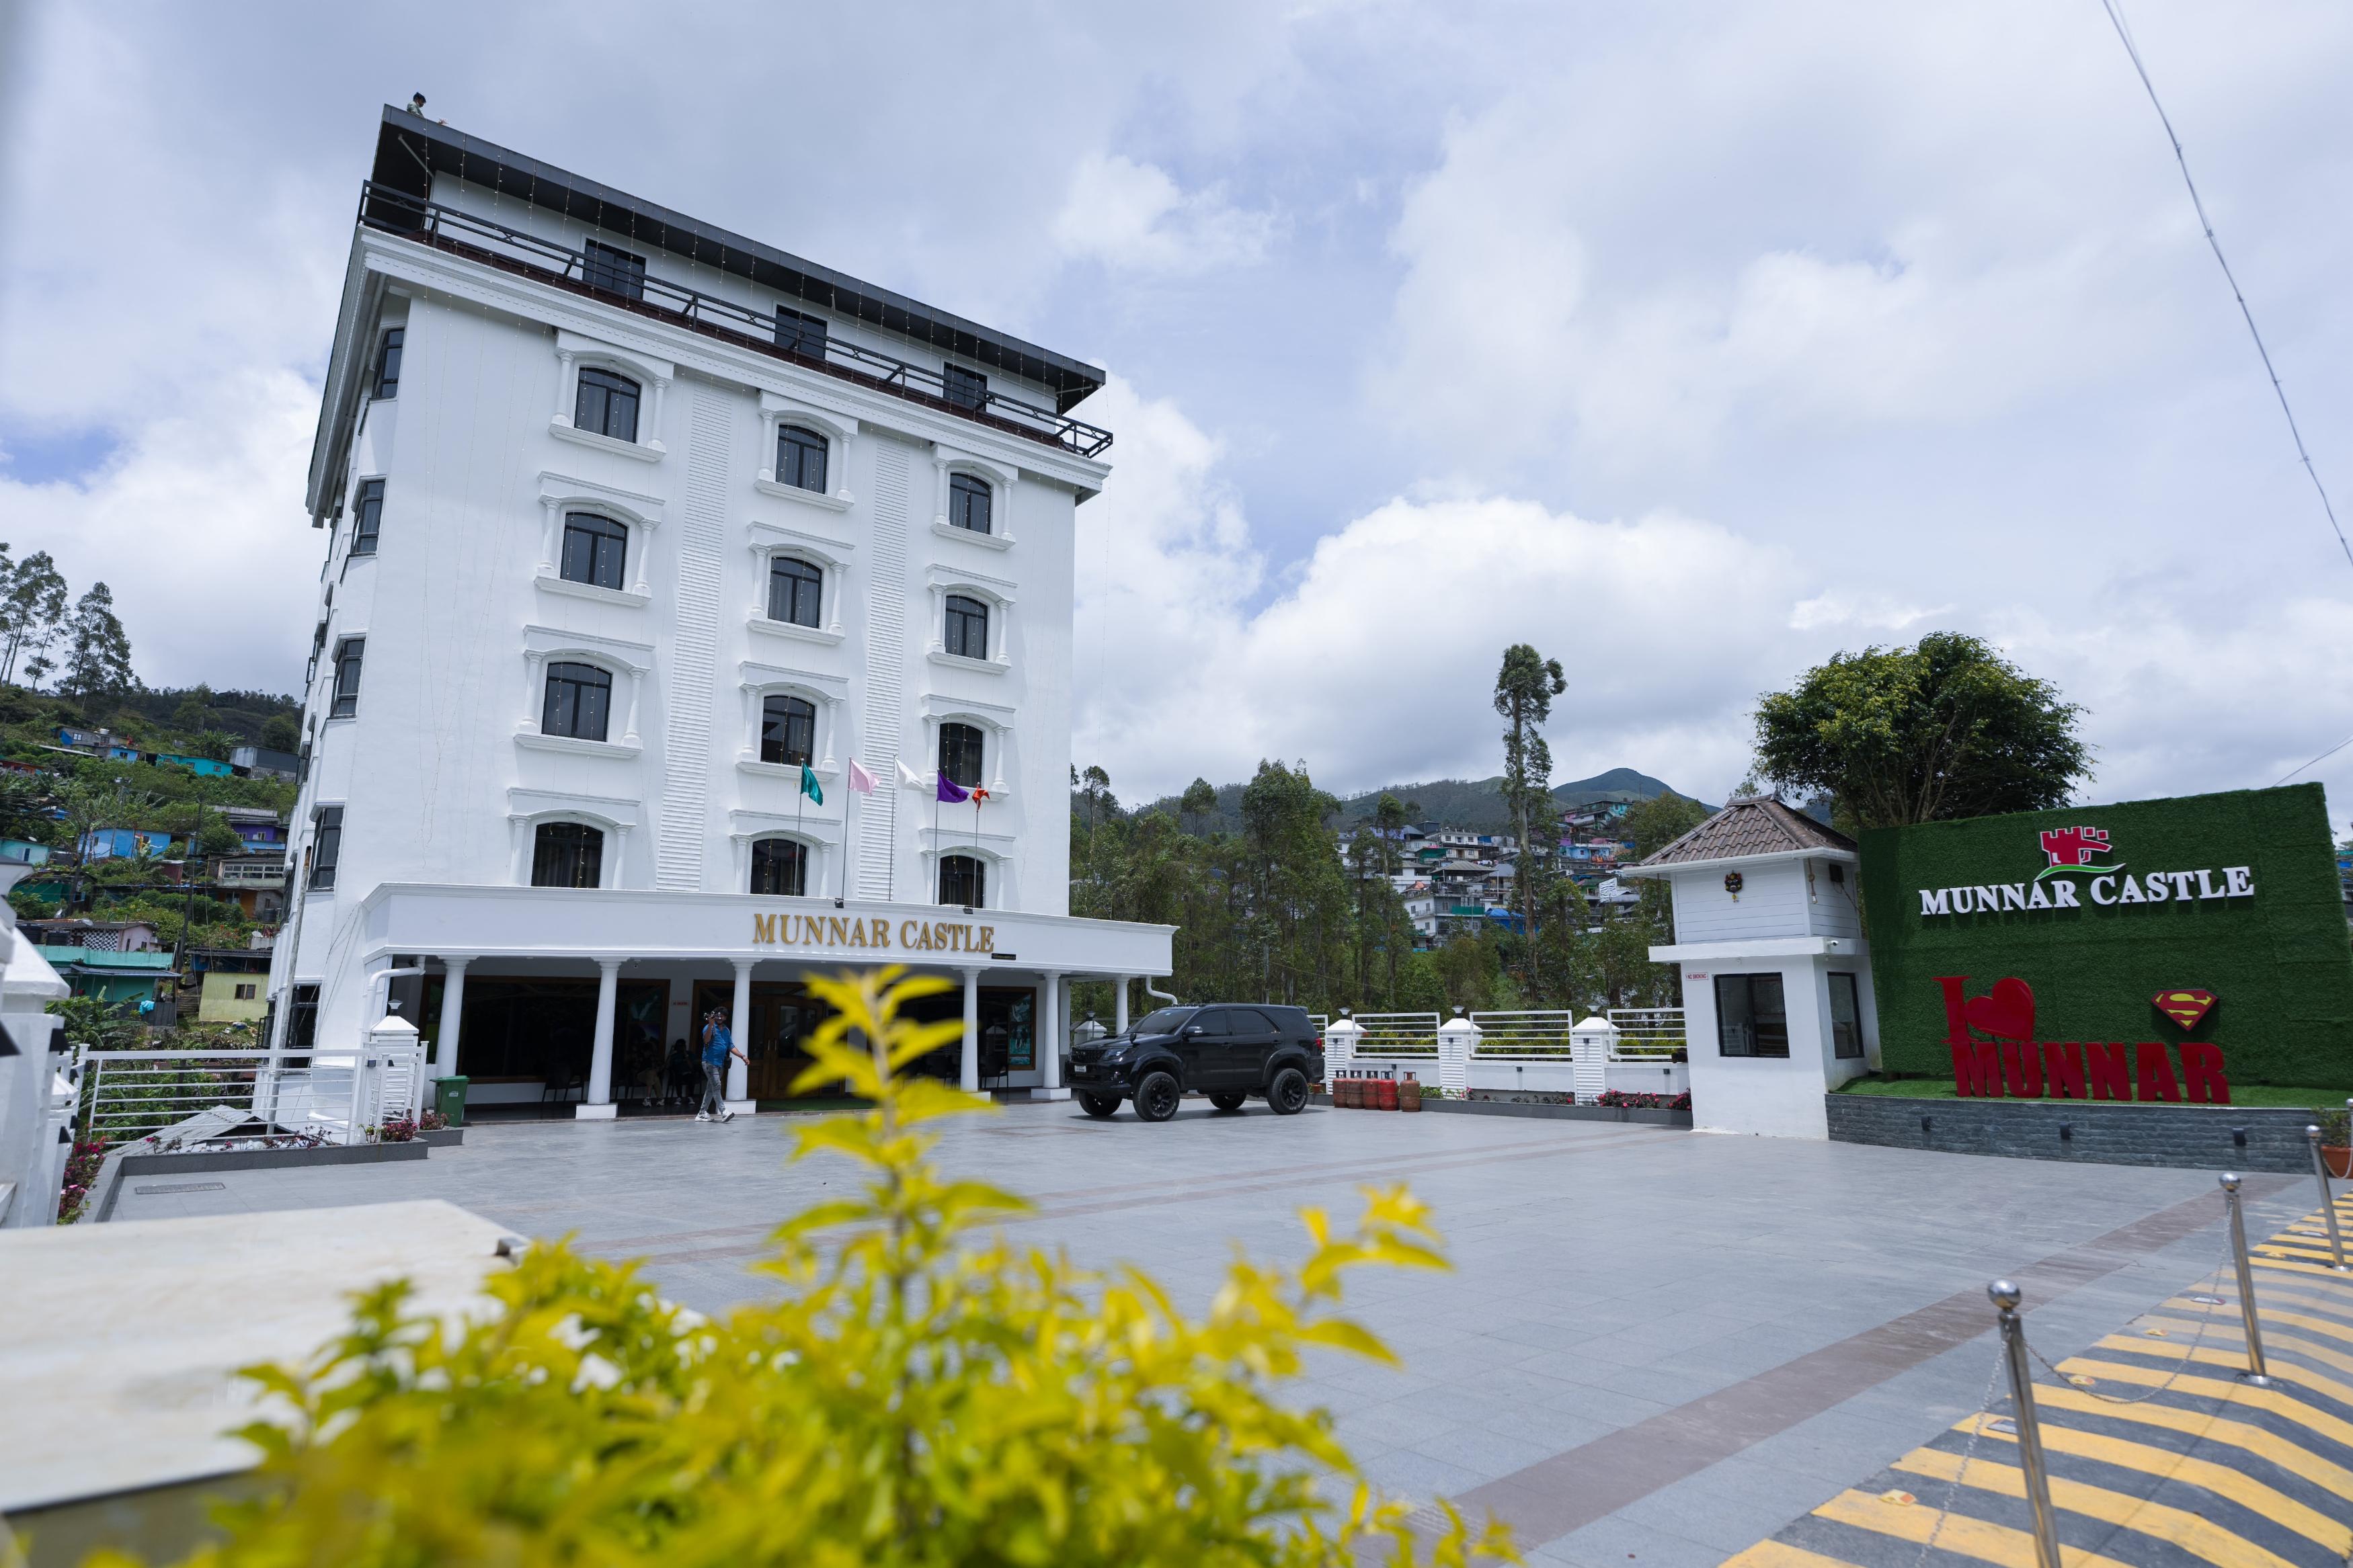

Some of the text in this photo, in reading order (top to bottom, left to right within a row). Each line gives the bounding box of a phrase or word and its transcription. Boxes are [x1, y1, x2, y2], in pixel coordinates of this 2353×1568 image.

[1919, 866, 2255, 915] MUNNAR CASTLE
[752, 913, 995, 953] MUNNAR CASTLE
[1931, 975, 1979, 1044] I
[1951, 1041, 2231, 1104] MUNNAR
